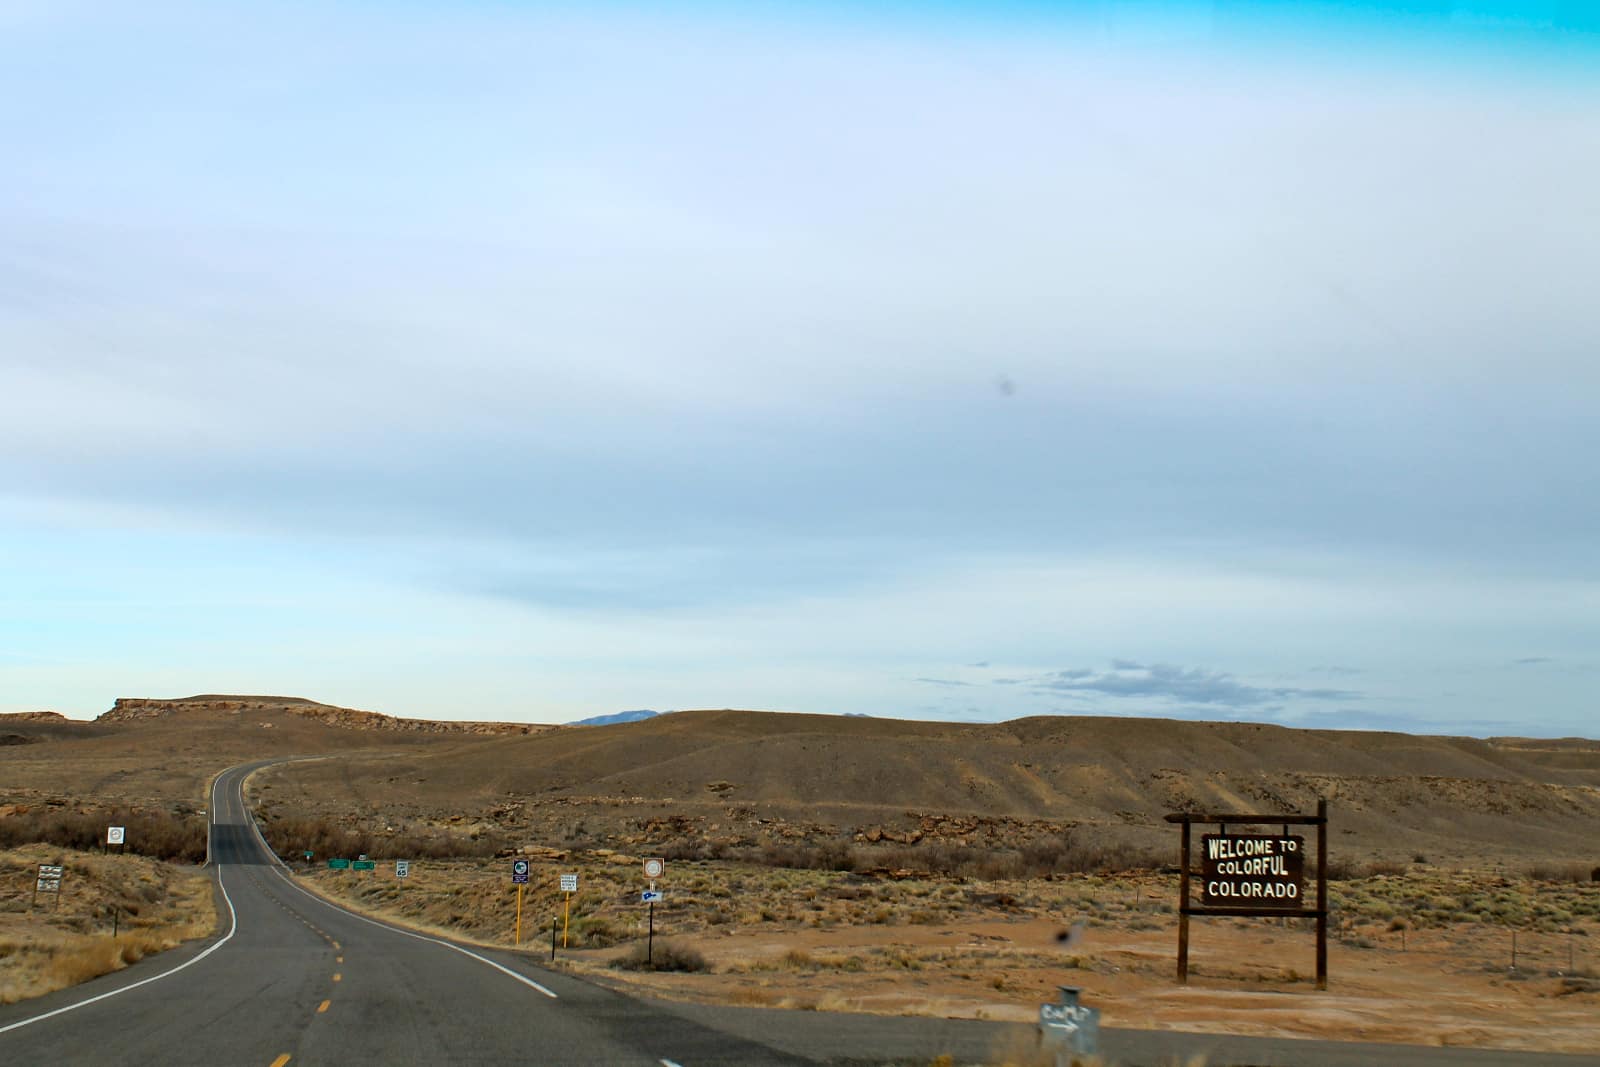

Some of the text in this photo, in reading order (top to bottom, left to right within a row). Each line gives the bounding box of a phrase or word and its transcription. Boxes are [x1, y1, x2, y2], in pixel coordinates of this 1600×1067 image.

[1208, 839, 1297, 860] WELCOME TO
[1217, 855, 1289, 876] COLORFUL
[1208, 881, 1298, 898] COLORADO
